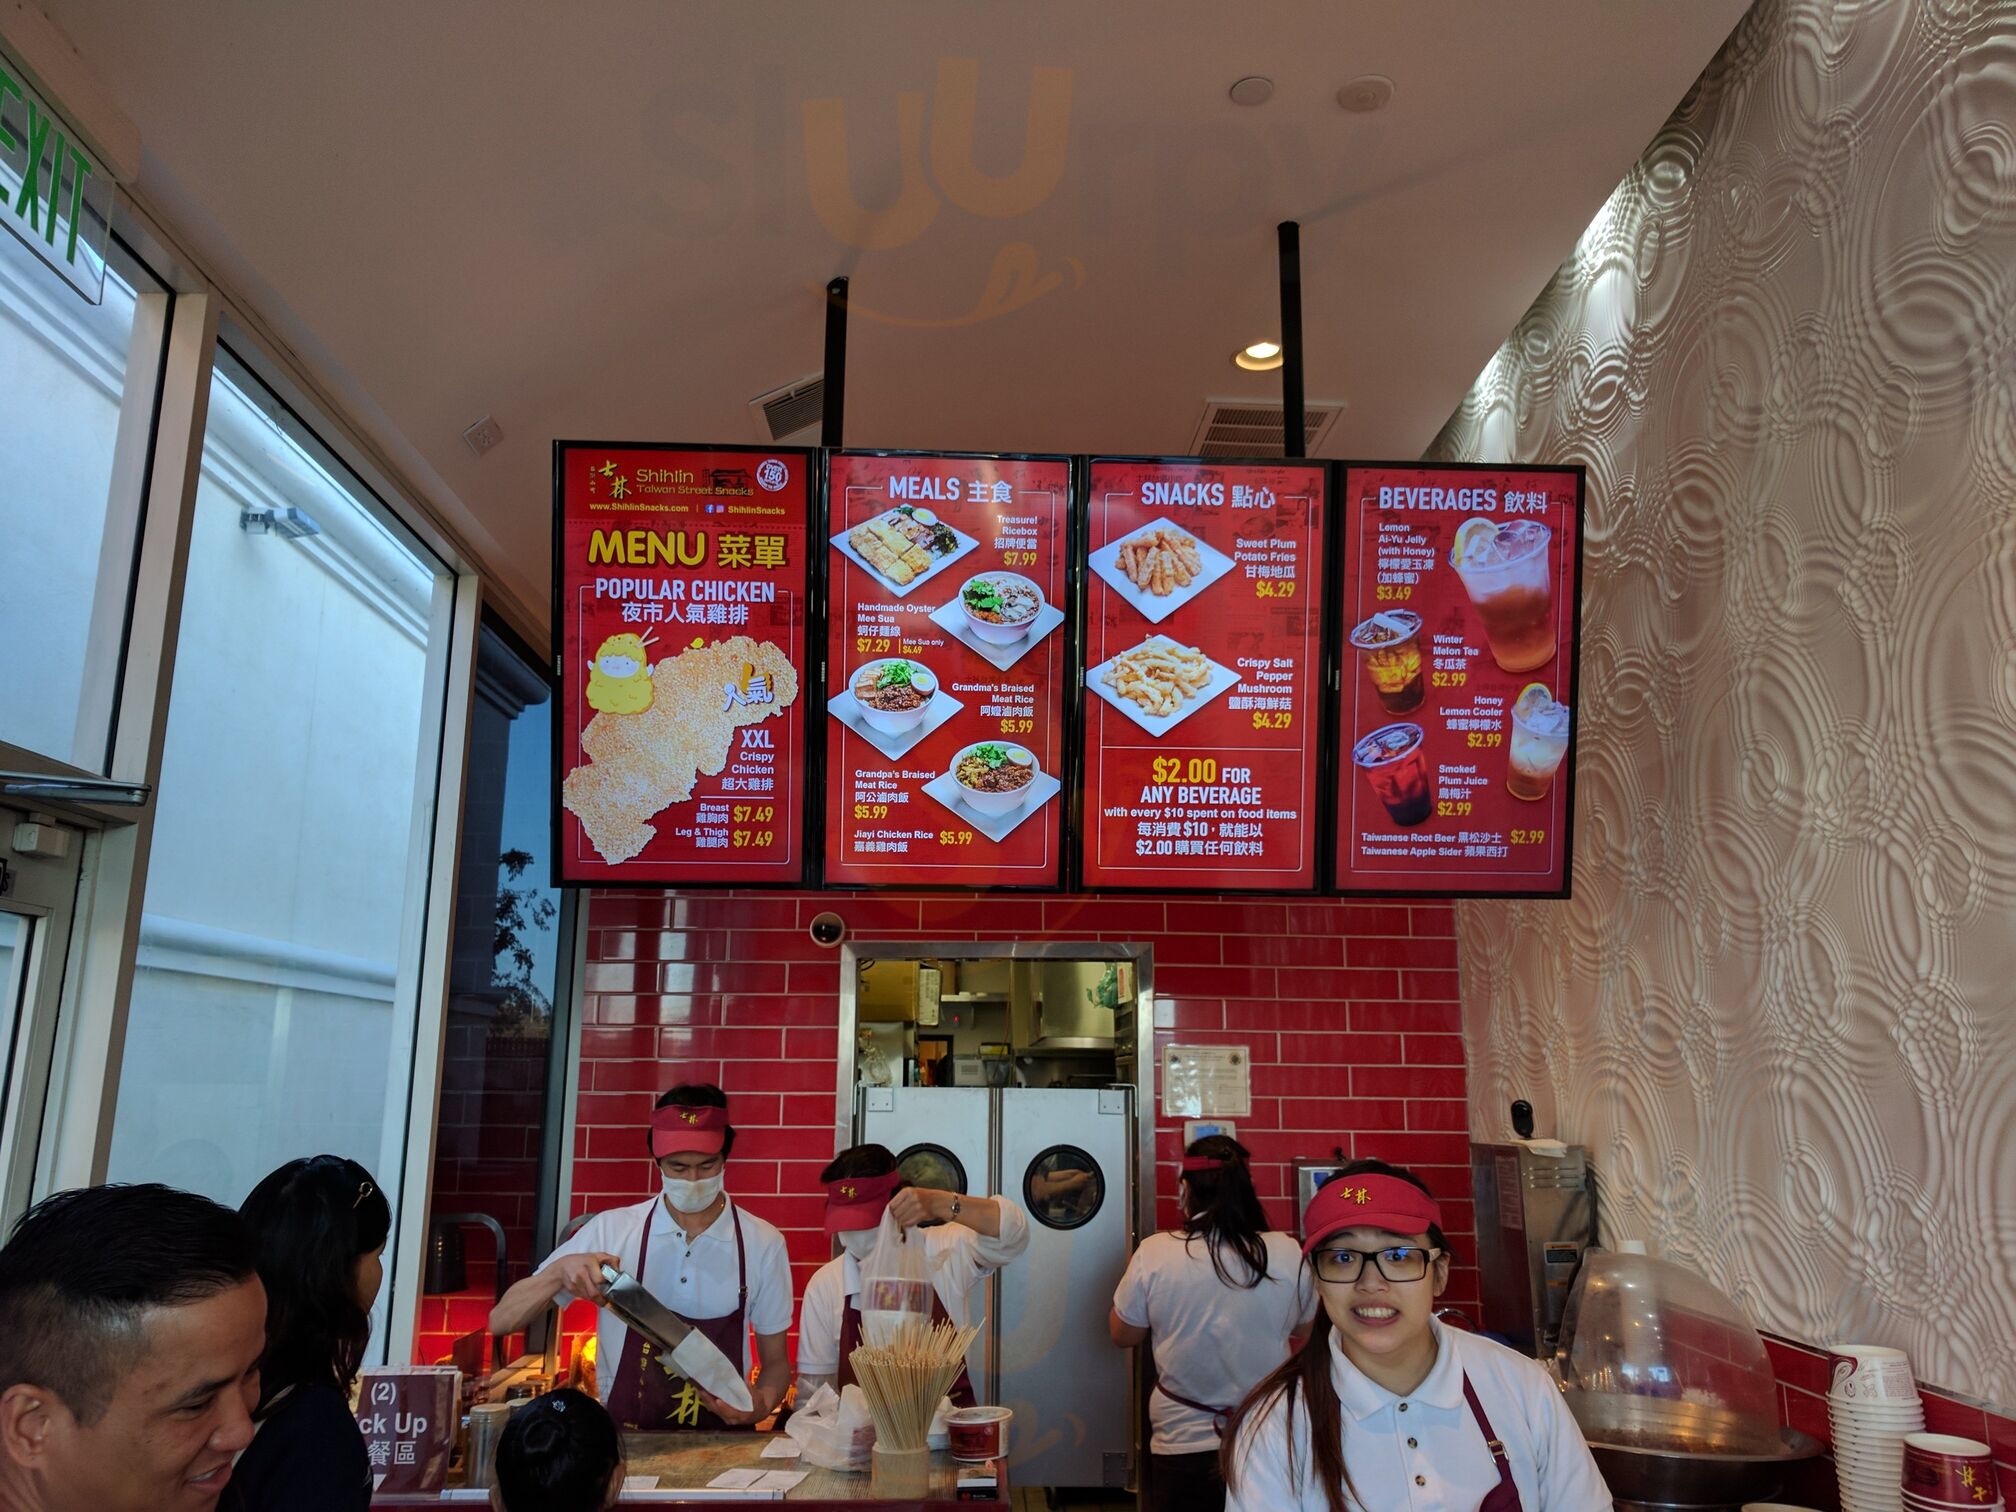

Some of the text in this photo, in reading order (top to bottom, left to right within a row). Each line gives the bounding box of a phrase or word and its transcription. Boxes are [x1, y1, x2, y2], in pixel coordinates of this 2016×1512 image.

[599, 460, 632, 499] 士林
[636, 468, 694, 483] Shihlin
[764, 469, 782, 483] 150
[636, 484, 754, 496] Taiwan Street Snacks
[890, 476, 1013, 504] MEALS 主食
[1141, 482, 1275, 509] SNACKS 點心
[1379, 487, 1548, 514] BEVERAGES 飲料
[589, 502, 689, 513] www.ShihlinSnacks.com
[728, 506, 785, 515] ShihlinSnacks
[1002, 526, 1038, 536] Ricebox
[1378, 523, 1410, 532] Lemon
[994, 538, 1037, 550] 招牌便當
[1236, 538, 1297, 549] Sweet Plum
[1378, 535, 1427, 546] Ai-Yu Jelly
[588, 530, 786, 568] MENU 菜單
[1378, 547, 1435, 558] (with Honey)
[1003, 551, 1037, 566] $7.99
[1234, 552, 1297, 562] Potato Fries
[1244, 565, 1296, 579] 甘梅地瓜
[596, 578, 775, 603] POPULAR CHICKEN
[1256, 581, 1296, 599] $4.29
[1376, 586, 1412, 601] $3.49
[622, 602, 748, 624] 夜市人氣雞排
[857, 603, 935, 615] Handmade Oyster
[857, 613, 895, 623] Mee Sua
[857, 637, 890, 653] $7.29
[903, 638, 944, 648] Mee Sua only
[1433, 635, 1464, 644] Winter
[903, 645, 922, 654] $4.49
[1433, 646, 1479, 656] Melon Tea
[1237, 657, 1293, 670] Crispy Salt
[1433, 658, 1467, 670] 冬瓜茶
[1256, 671, 1293, 682] Pepper
[1432, 672, 1467, 687] $2.99
[723, 676, 774, 712] 人氣
[952, 683, 1034, 693] Grandma's Braised
[1237, 684, 1293, 694] Mushroom
[992, 695, 1034, 704] Meat Rice
[1474, 696, 1503, 706] Honey
[1439, 707, 1503, 716] Lemon Cooler
[1252, 711, 1292, 729] $4.29
[1000, 719, 1033, 734] $5.99
[741, 729, 774, 749] XXL
[1467, 733, 1502, 748] $2.99
[740, 751, 774, 763] Crispy
[731, 764, 774, 775] Chicken
[855, 769, 936, 780] Grandpa's Braised
[1152, 756, 1251, 785] $2.00 FOR
[1439, 765, 1476, 774] Smoked
[721, 778, 774, 792] 超大雞排
[855, 781, 897, 789] Meat Rice
[1438, 776, 1488, 786] Plum Juice
[1140, 786, 1262, 805] ANY BEVERAGE
[700, 803, 729, 812] Breast
[854, 805, 888, 820] $5.99
[1437, 801, 1472, 817] $2.99
[696, 812, 729, 824] 雞胸肉
[733, 806, 773, 823] $7.49
[1104, 808, 1297, 820] with every $10 spent on food items
[675, 828, 729, 838] Leg & Thigh
[733, 831, 773, 847] $7.49
[854, 830, 934, 841] Jiayi Chicken Rice
[940, 831, 973, 846] $5.99
[1361, 832, 1502, 844] Taiwanese Root Beer 黑松沙士
[1510, 830, 1545, 845] $2.99
[695, 837, 729, 849] 雞腿肉
[1361, 846, 1408, 856] Taiwanese
[1409, 847, 1437, 858] Apple
[1438, 847, 1463, 857] Sider
[1340, 1187, 1372, 1204] 士林
[371, 1382, 397, 1406] (2)
[354, 1412, 428, 1439] ck Up
[367, 1440, 417, 1466] 餐區
